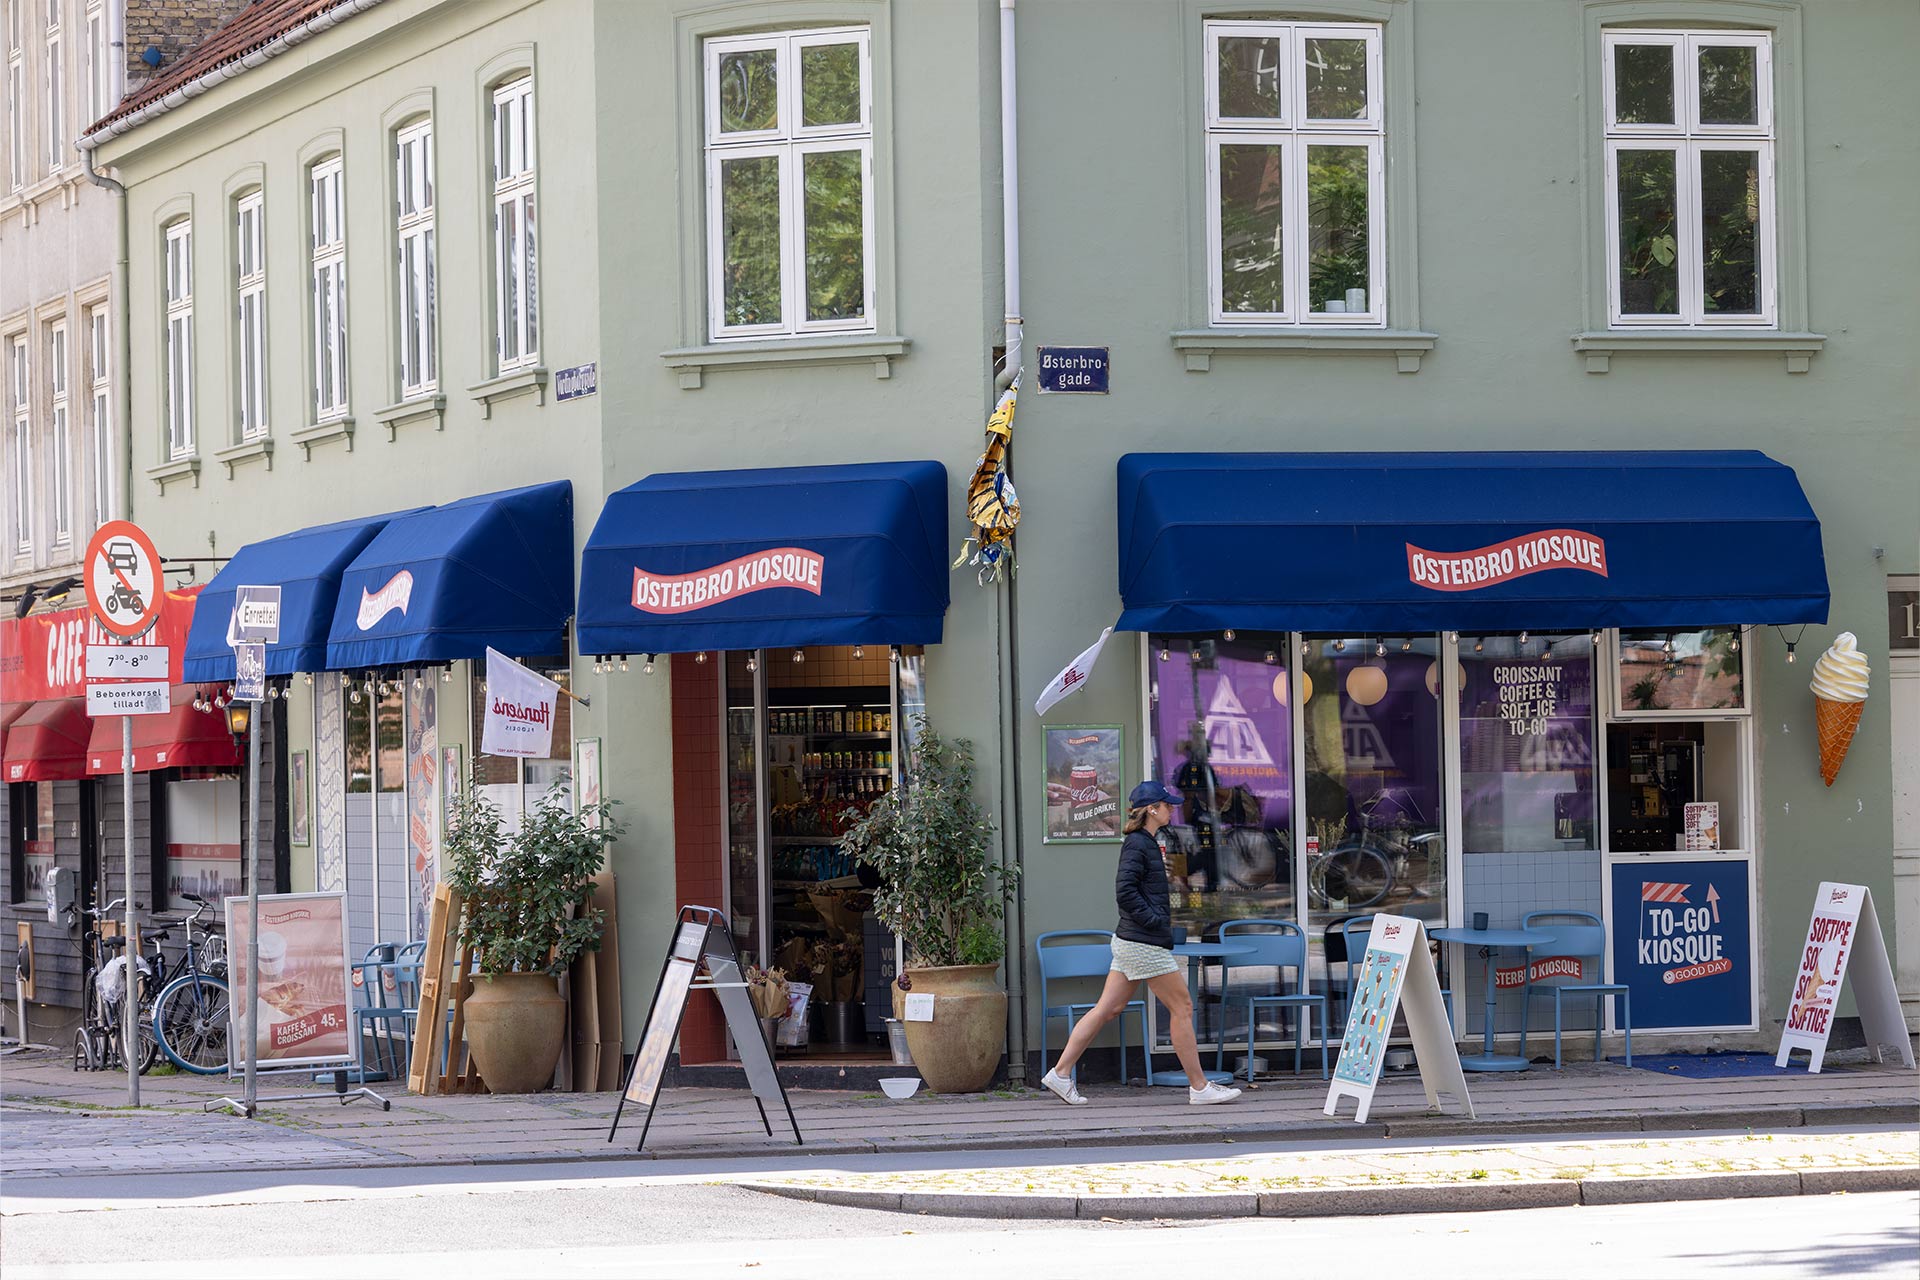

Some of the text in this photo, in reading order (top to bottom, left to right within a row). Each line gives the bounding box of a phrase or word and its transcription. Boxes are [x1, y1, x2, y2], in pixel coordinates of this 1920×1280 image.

[1059, 371, 1091, 389] gade
[1412, 535, 1602, 585] ØSTERBRO KIOSQUE
[637, 553, 819, 608] ØSTERBRO KIOSQUE
[1493, 666, 1563, 684] CROISSANT
[95, 688, 162, 699] Beboerkørsel
[1500, 682, 1557, 702] COFFEE &
[113, 700, 144, 708] tilladt
[1501, 699, 1556, 719] SOFT-ICE
[1509, 718, 1548, 736] TO-GO
[1073, 807, 1093, 822] KOLDE
[1649, 907, 1710, 936] TO-GO
[1638, 935, 1723, 965] KIOSQUE
[1495, 959, 1580, 986] STERBO KIOSQUE
[1675, 961, 1728, 980] GOOD DAY
[277, 1019, 307, 1036] KAFFE &
[277, 1024, 317, 1045] CROISSANT
